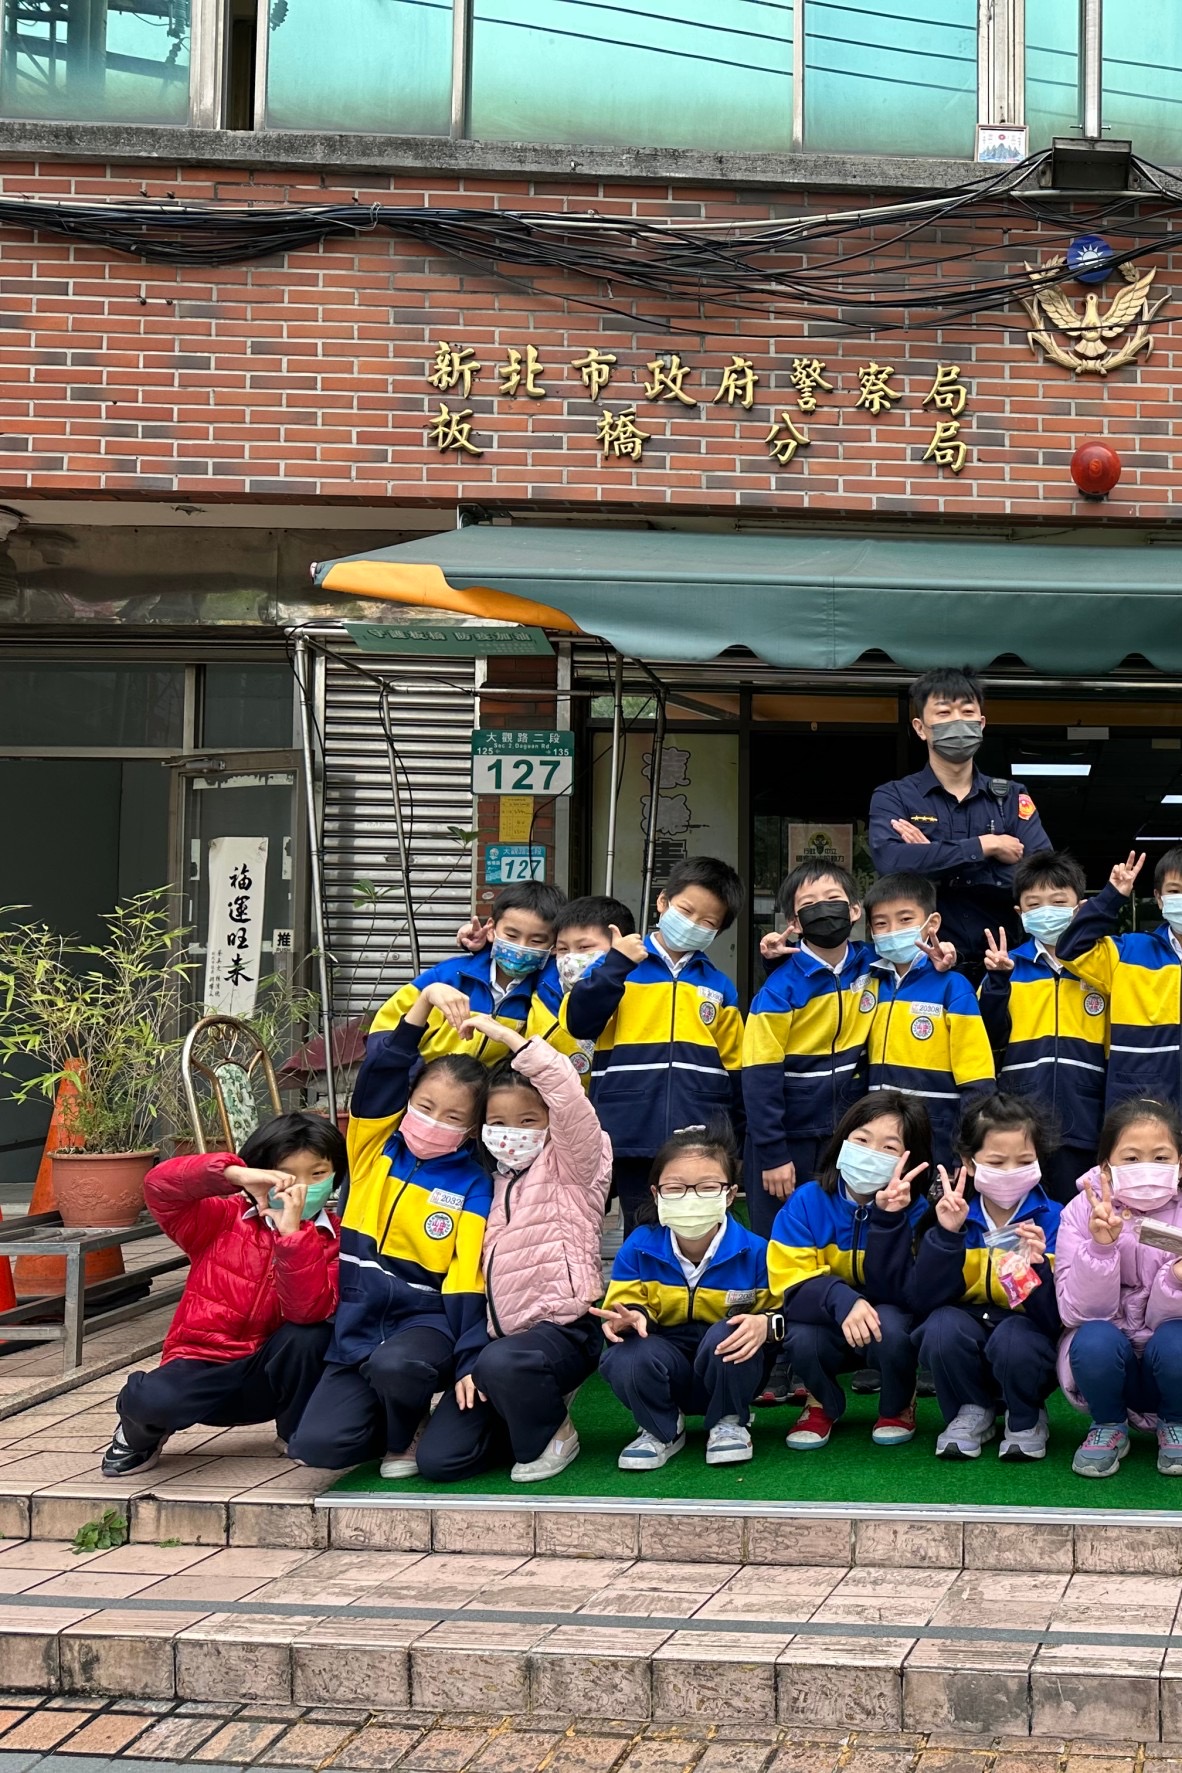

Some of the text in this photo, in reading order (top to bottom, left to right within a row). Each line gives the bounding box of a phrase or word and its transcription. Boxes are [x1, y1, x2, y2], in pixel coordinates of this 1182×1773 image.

[427, 341, 969, 417] 新北市政府警察局
[428, 403, 968, 473] 板橋分局
[486, 732, 560, 744] 大觀路二段
[477, 747, 493, 755] 125
[553, 748, 569, 756] 135
[487, 759, 561, 790] 127
[505, 859, 542, 879] 127
[224, 863, 254, 986] 福運旺來
[277, 932, 291, 946] 推
[919, 1004, 940, 1013] 20308
